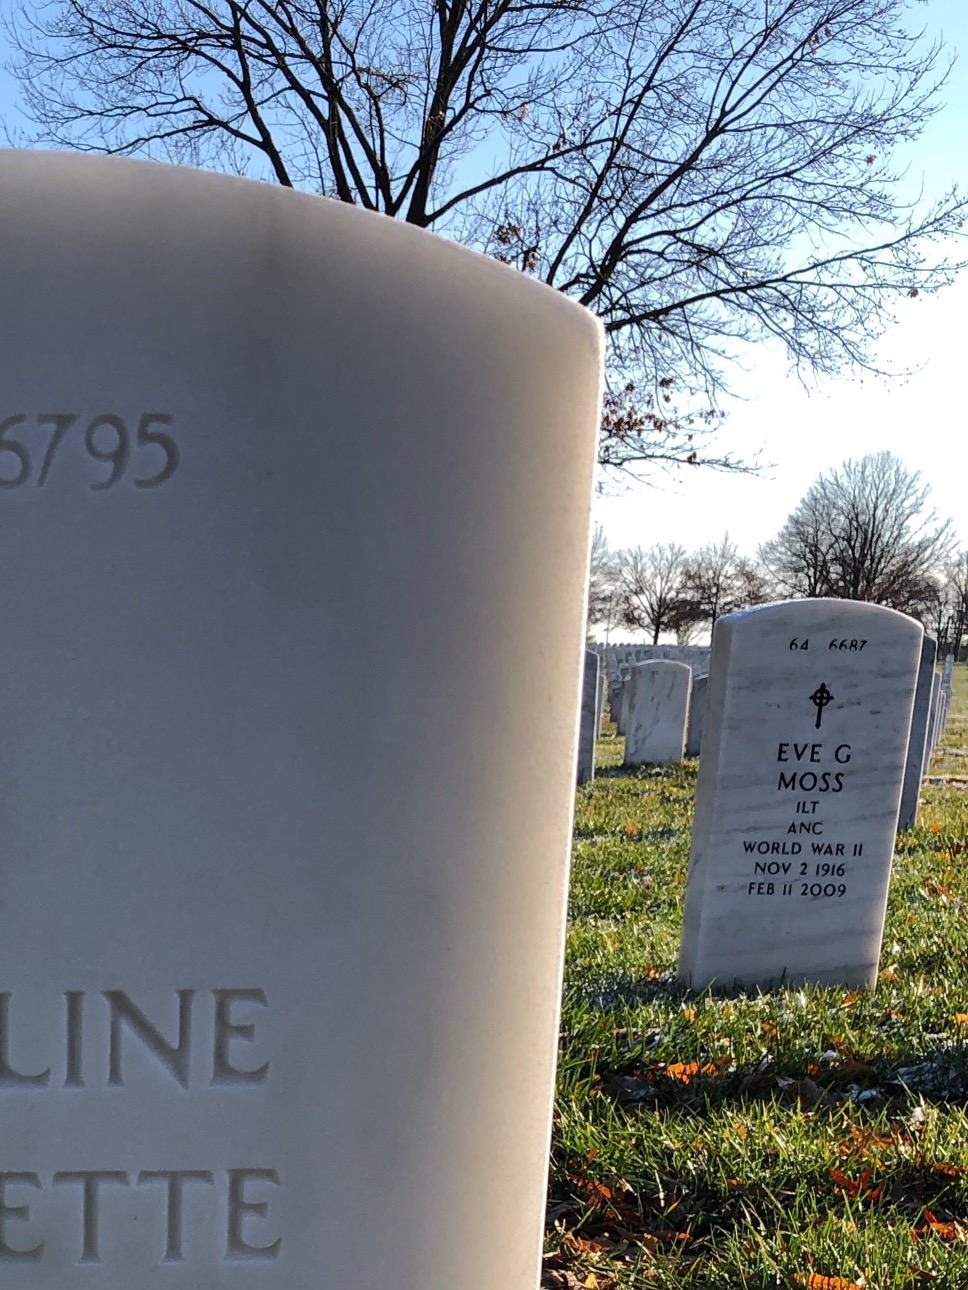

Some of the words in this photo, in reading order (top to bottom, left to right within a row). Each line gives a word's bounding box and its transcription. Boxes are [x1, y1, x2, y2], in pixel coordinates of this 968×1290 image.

[789, 638, 809, 650] 64
[829, 638, 868, 652] 6687
[777, 743, 822, 763] EVE
[835, 744, 851, 765] G
[777, 772, 844, 792] MOSS
[787, 822, 823, 835] ANC
[743, 840, 802, 855] WORLD
[811, 842, 845, 856] WAR
[853, 843, 863, 856] II
[754, 862, 792, 875] NOV
[799, 862, 808, 876] 2
[815, 863, 845, 877] 1916
[748, 882, 774, 895] FEB
[800, 883, 847, 897] 2009
